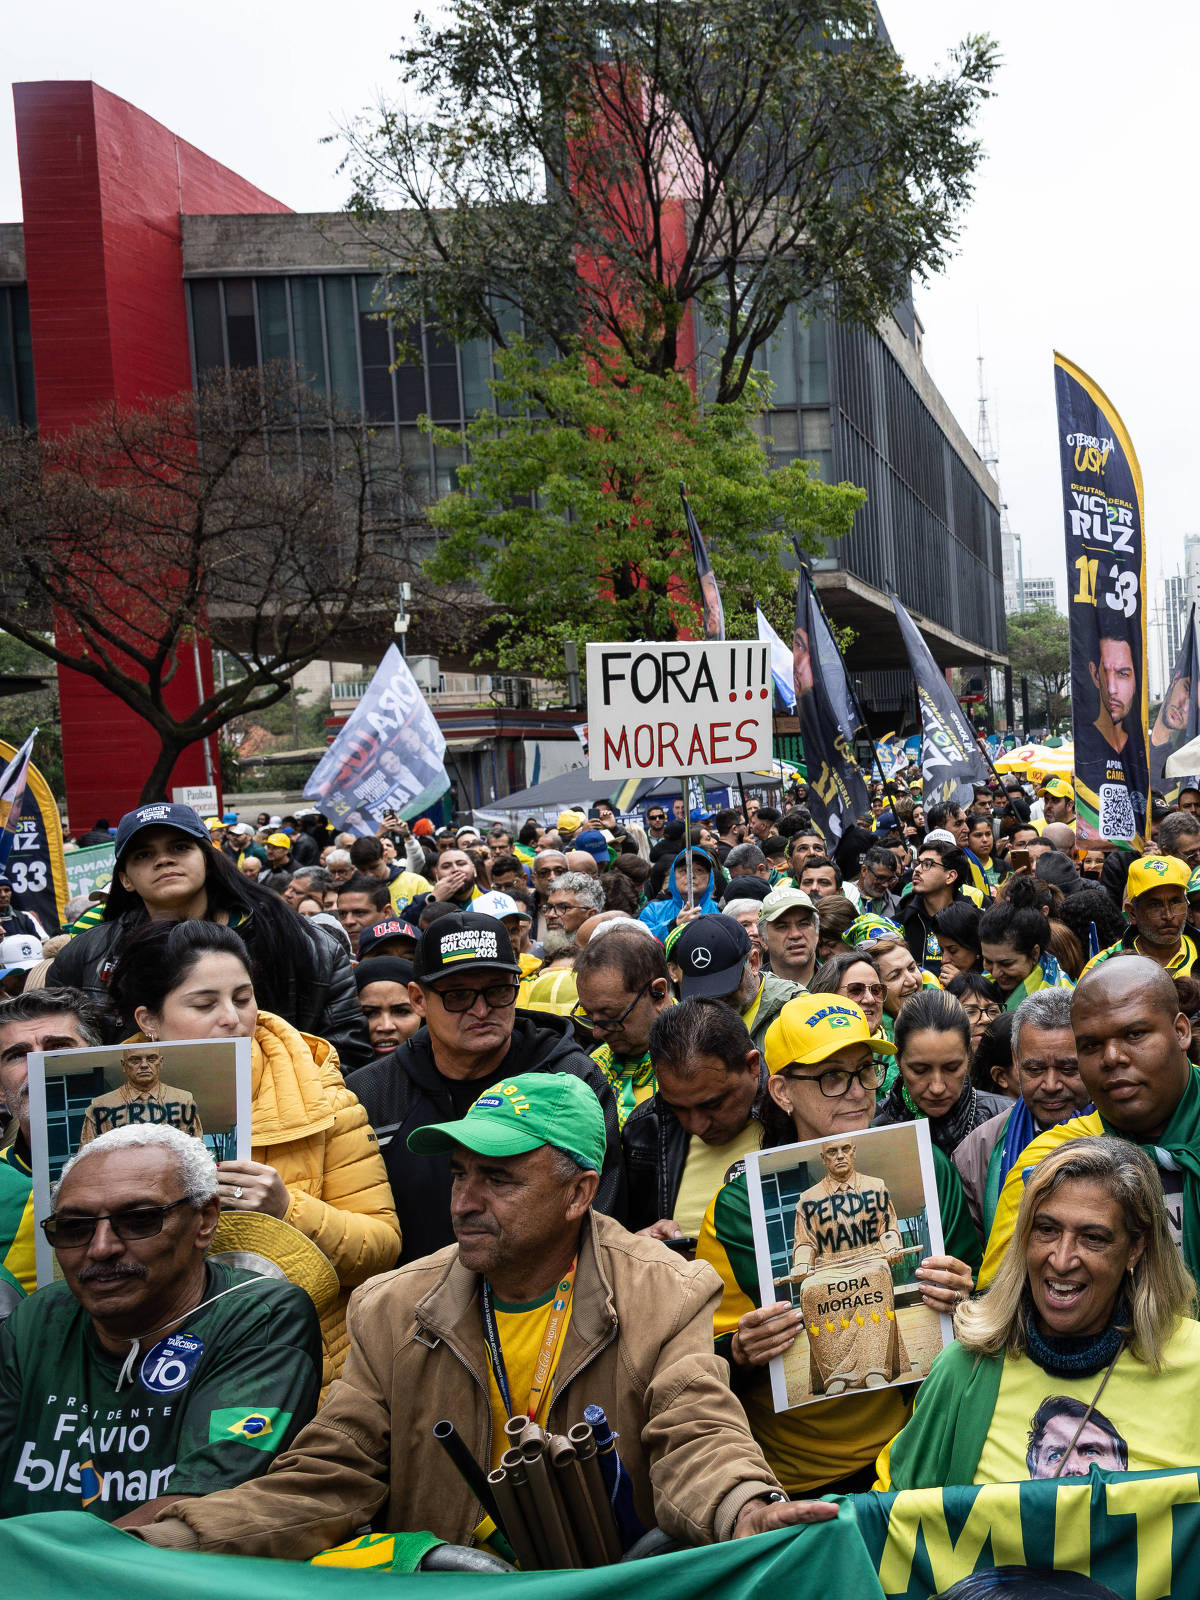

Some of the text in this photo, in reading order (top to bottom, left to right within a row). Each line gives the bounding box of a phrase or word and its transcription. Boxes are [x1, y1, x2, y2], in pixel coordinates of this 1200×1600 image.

[1069, 509, 1135, 554] RUZ
[604, 719, 759, 771] MORAES
[373, 921, 416, 938] U.S.A
[441, 930, 496, 943] #FECHADO COM
[440, 938, 497, 954] BOLSONARO
[475, 948, 498, 958] 2026
[805, 1006, 862, 1028] BRASIL
[93, 1101, 197, 1135] PERDEU
[802, 1190, 889, 1230] PERDEU
[827, 1276, 870, 1296] FORA
[817, 1290, 884, 1315] MORAES
[545, 1317, 559, 1347] ANDINA
[167, 1338, 198, 1351] TARCISIO
[148, 1356, 187, 1387] 10
